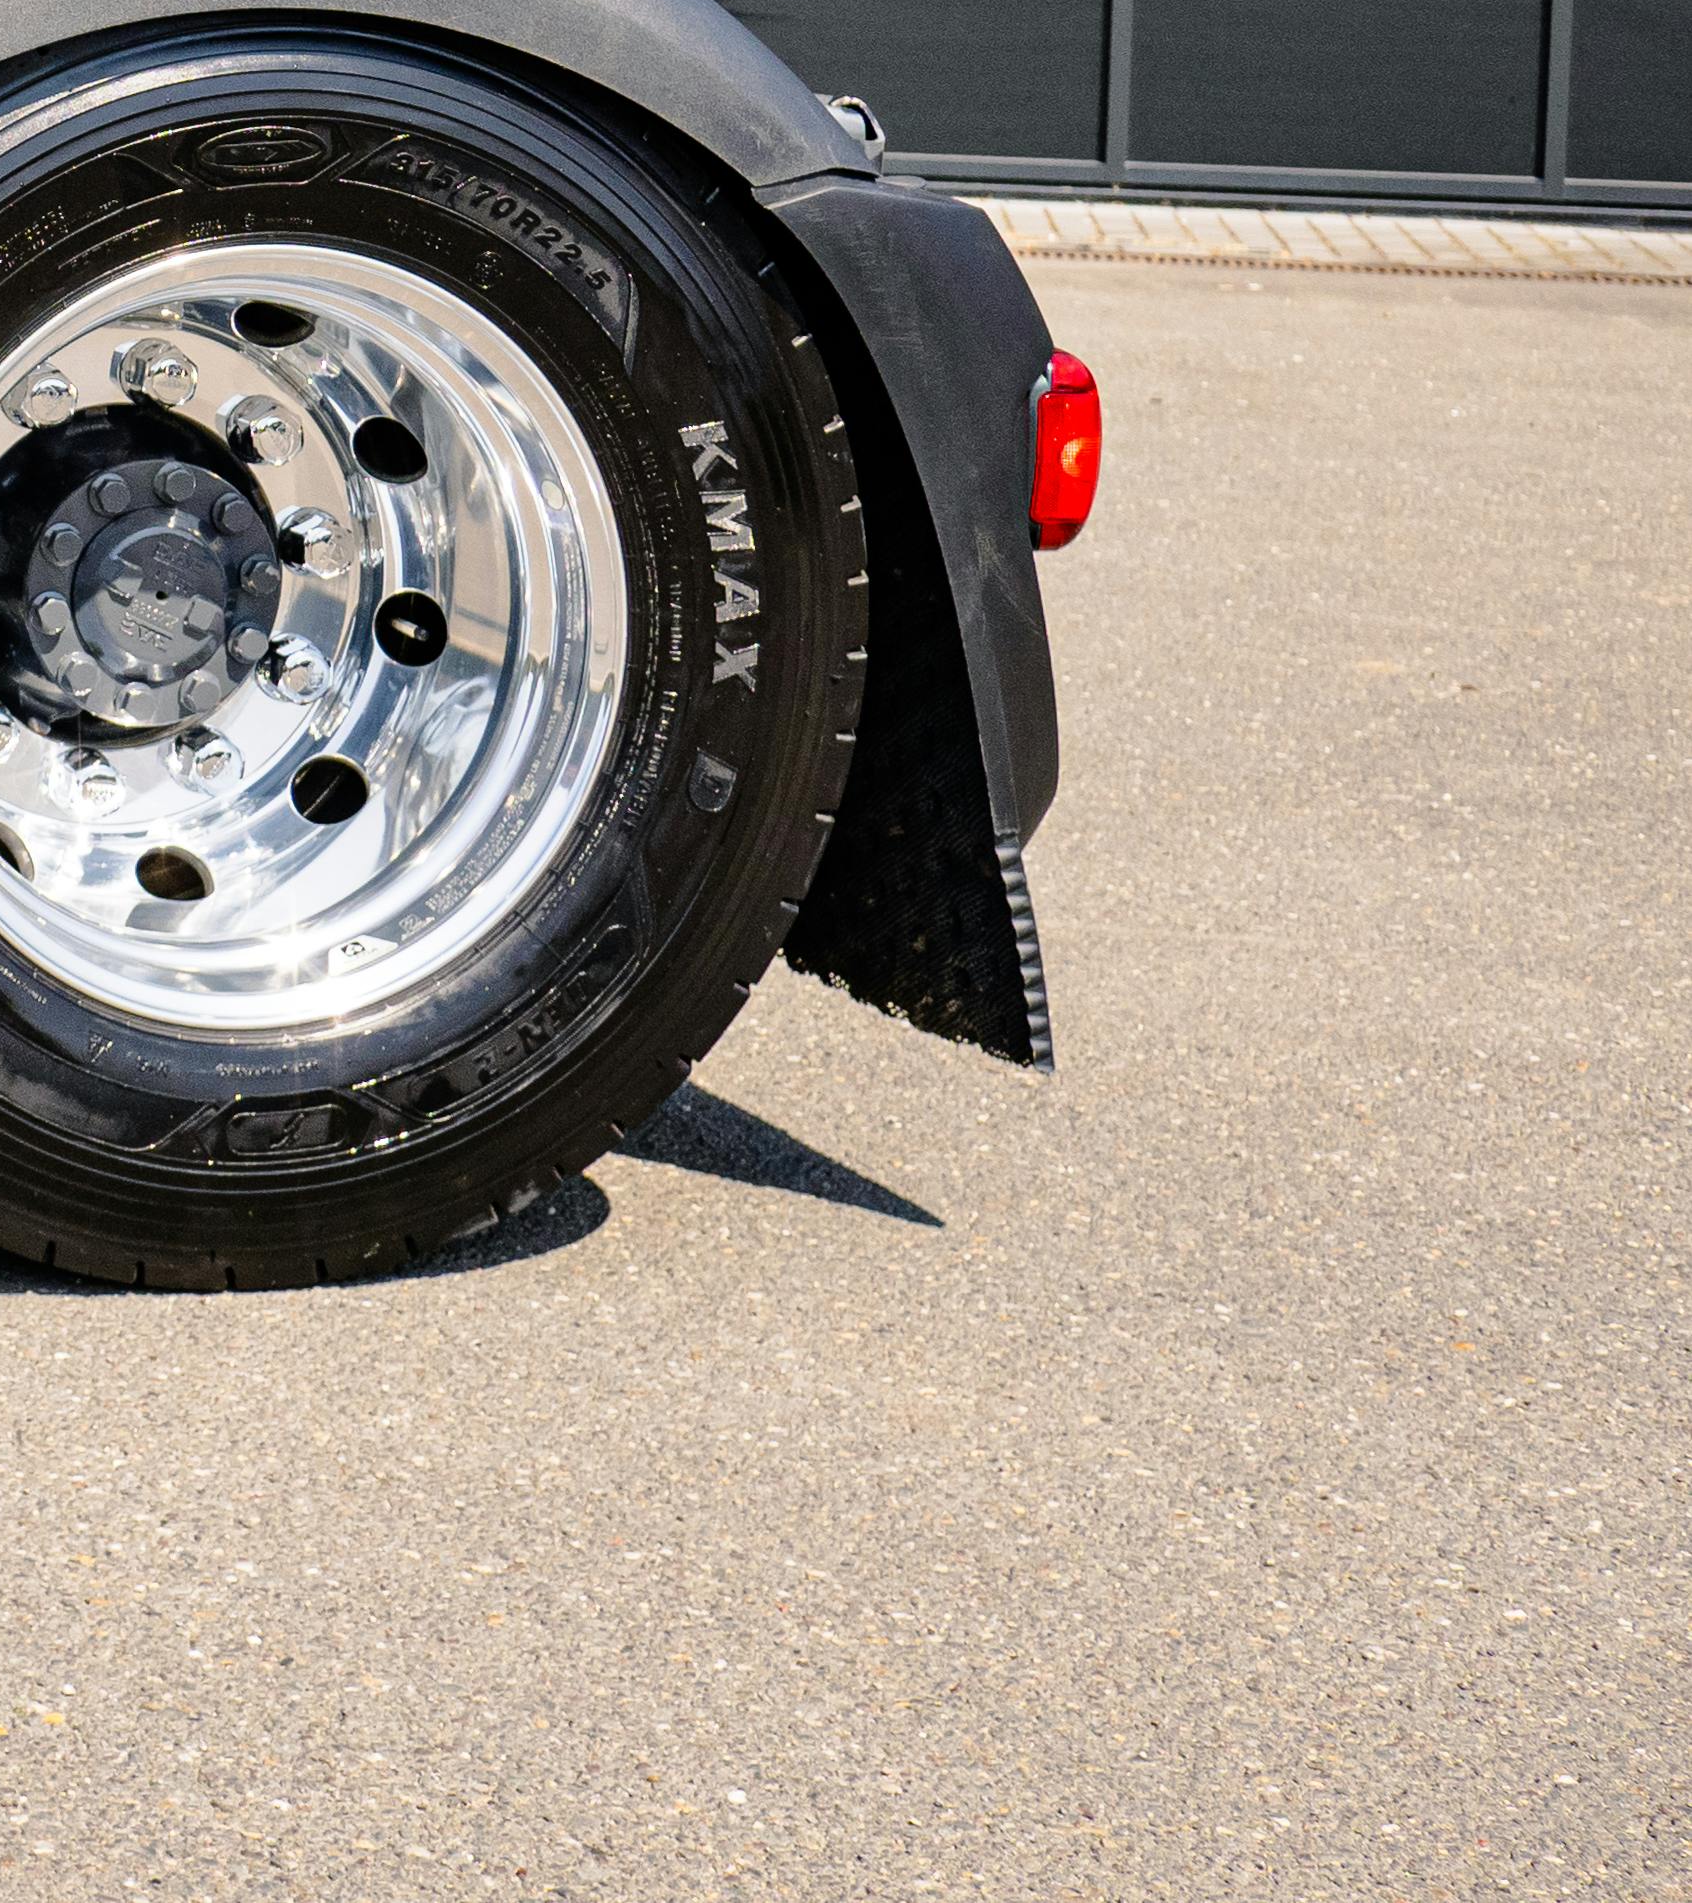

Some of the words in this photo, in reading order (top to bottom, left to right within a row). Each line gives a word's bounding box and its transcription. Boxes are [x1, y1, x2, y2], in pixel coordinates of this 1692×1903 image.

[392, 151, 613, 292] 315/70R22.5
[679, 419, 759, 693] KMAX
[686, 747, 740, 814] D
